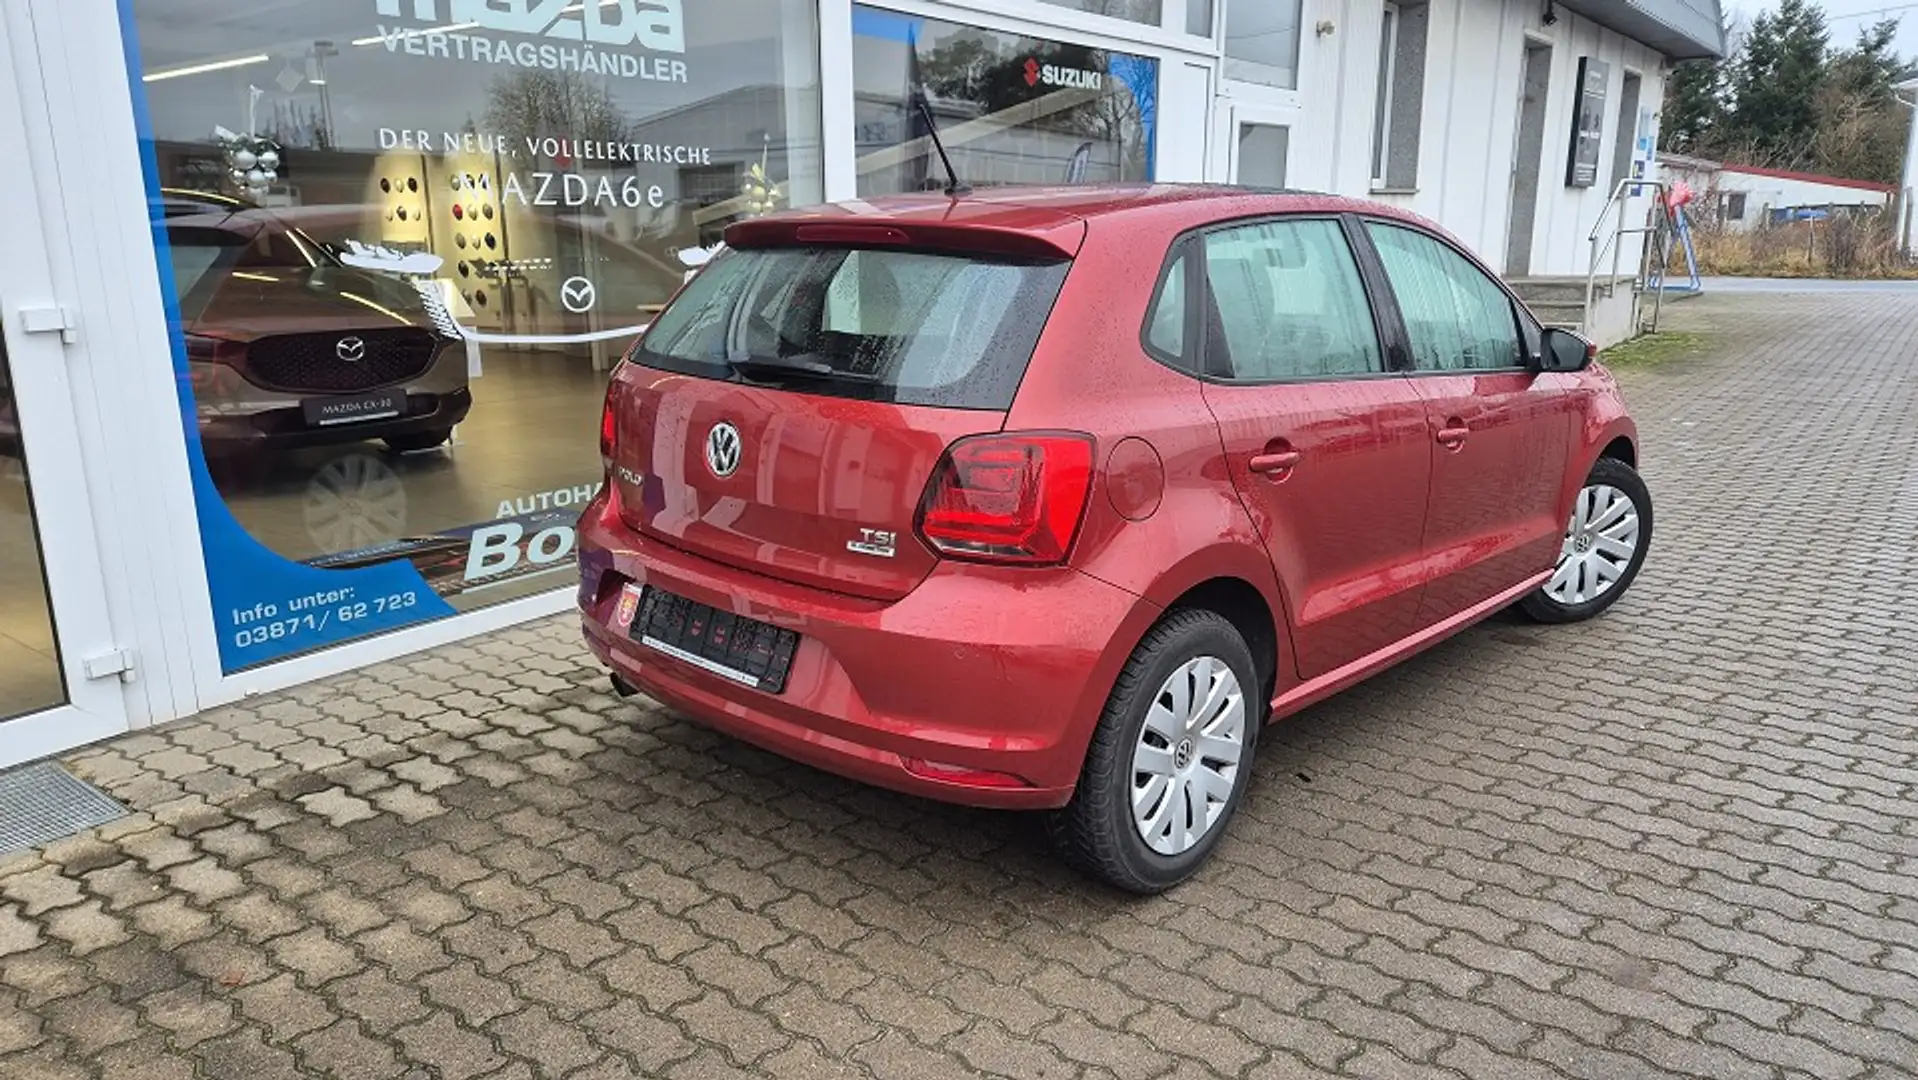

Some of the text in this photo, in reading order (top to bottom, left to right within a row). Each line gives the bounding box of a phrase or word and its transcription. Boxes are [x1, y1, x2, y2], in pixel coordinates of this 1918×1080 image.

[376, 24, 688, 83] VERTRAGSHÄNDLER
[1042, 64, 1101, 89] SUZUKI
[380, 128, 711, 165] DER NEUE, VOLLELEKTRISCHE
[322, 402, 361, 413] MAZDA
[859, 527, 897, 546] TSI
[232, 586, 355, 625] Info unter:
[235, 591, 417, 648] 03871/ 62 723
